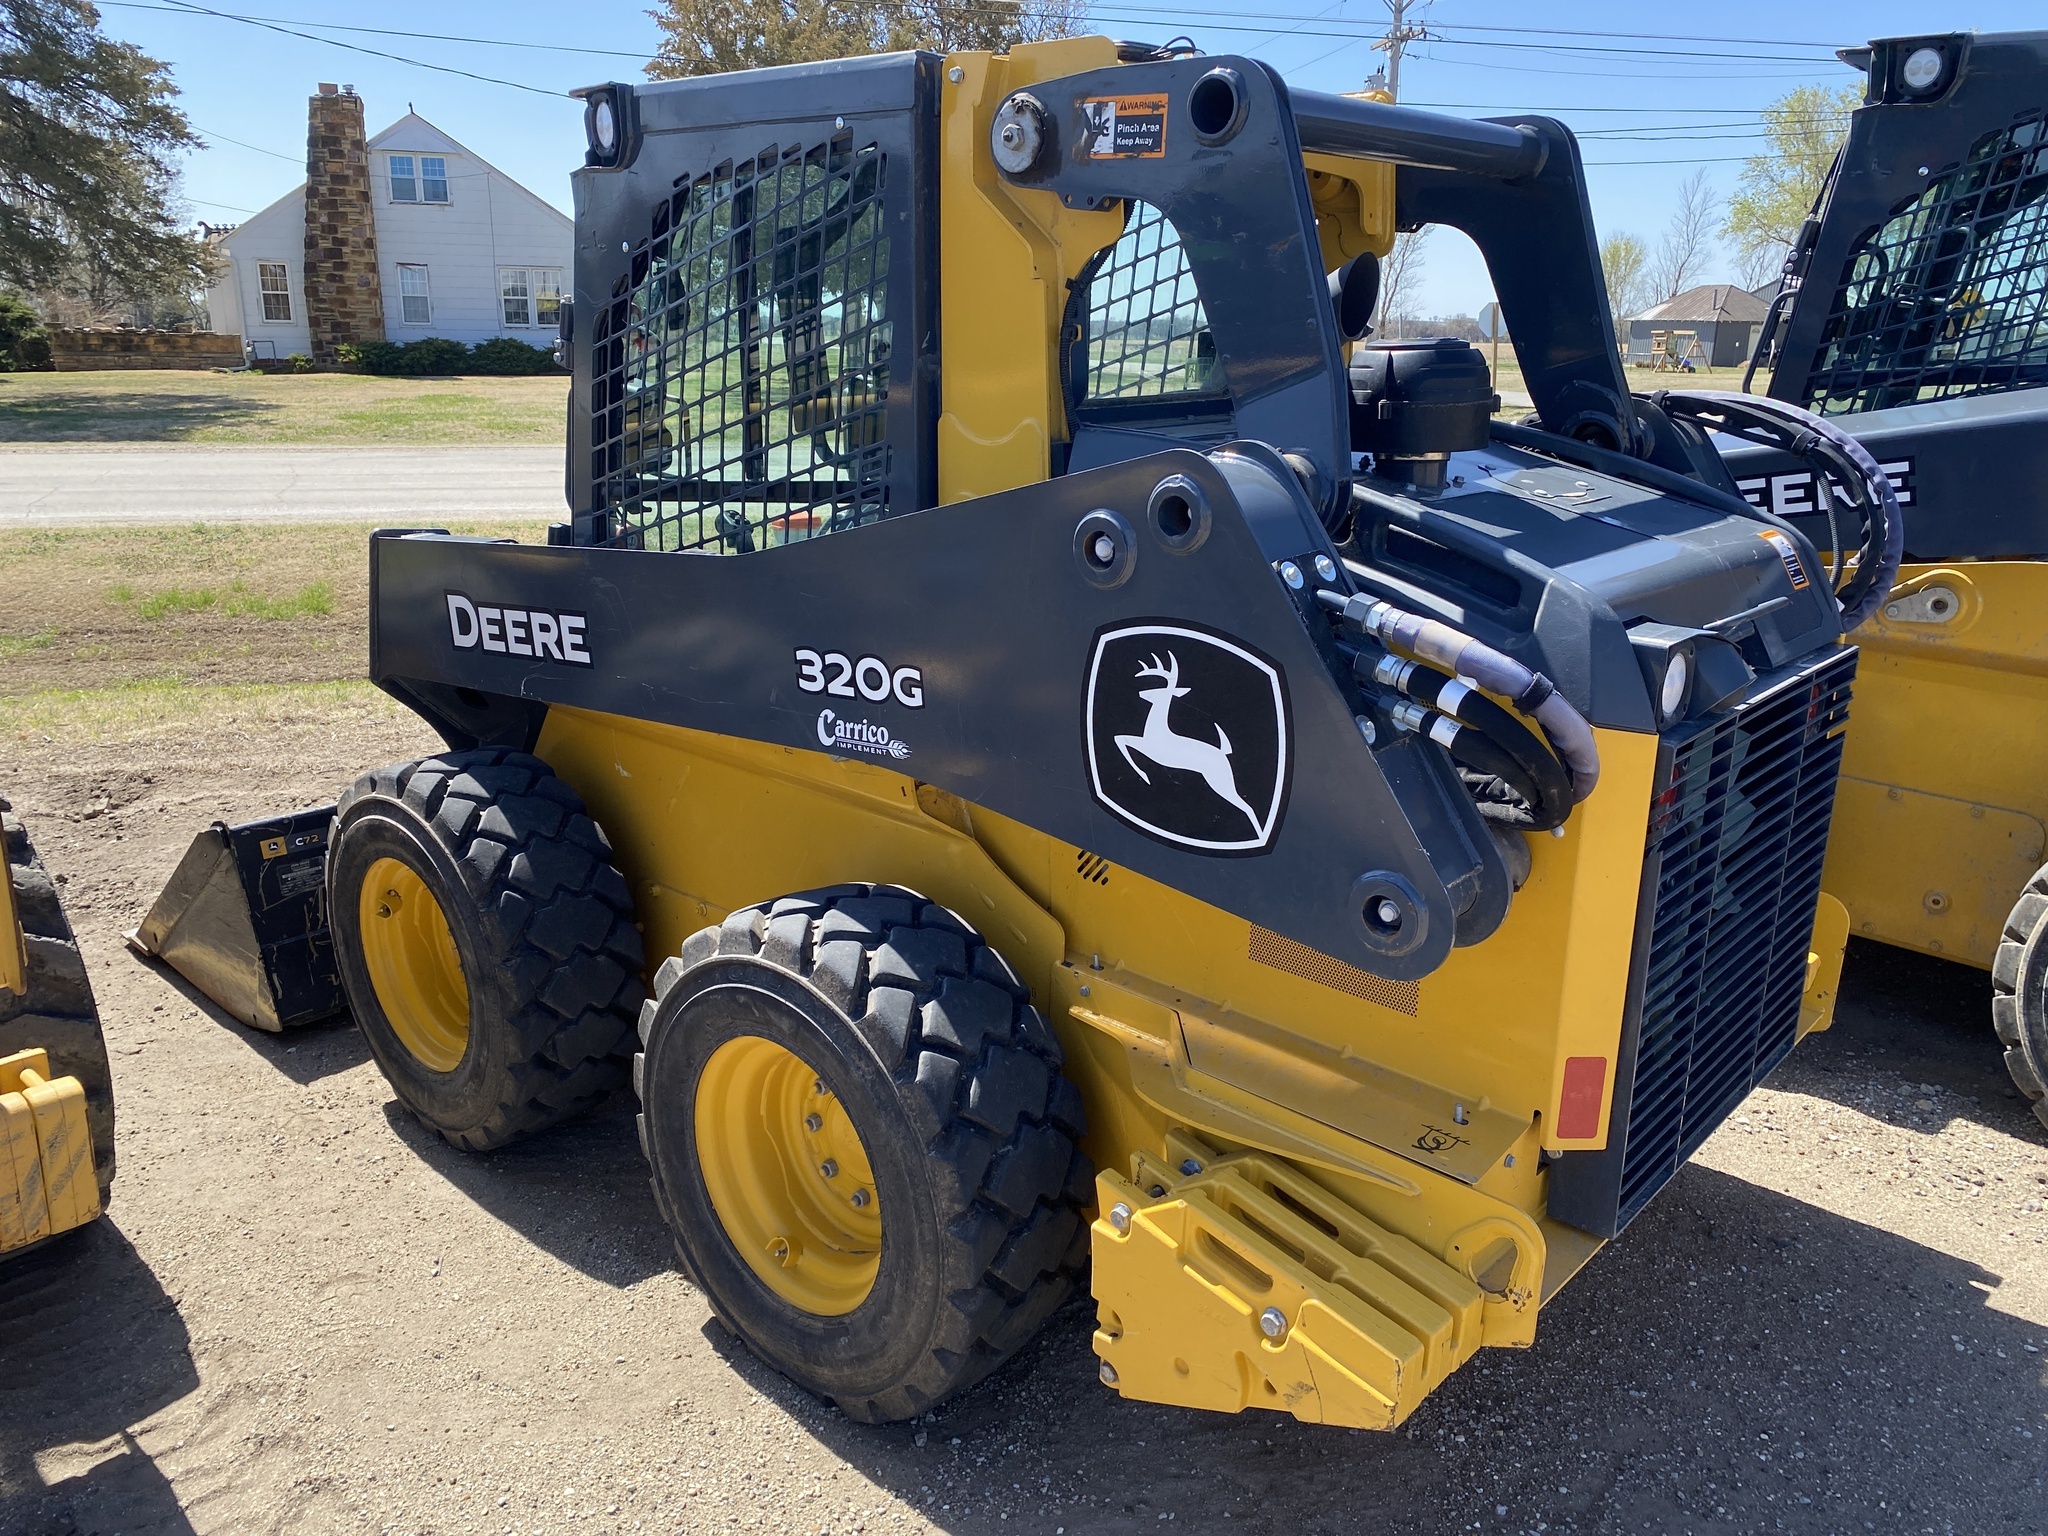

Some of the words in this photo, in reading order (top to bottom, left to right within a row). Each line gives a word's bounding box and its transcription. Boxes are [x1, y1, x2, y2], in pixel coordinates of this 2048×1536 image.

[1117, 123, 1139, 133] Pinch
[1140, 122, 1159, 132] Area
[1116, 137, 1133, 147] Keep
[1134, 136, 1153, 146] Away
[1735, 460, 1911, 515] EERE
[446, 594, 591, 664] DEERE
[795, 649, 923, 707] 320G
[817, 708, 889, 747] Carrico
[836, 741, 887, 756] IMPLEMENT
[295, 834, 319, 846] C72
